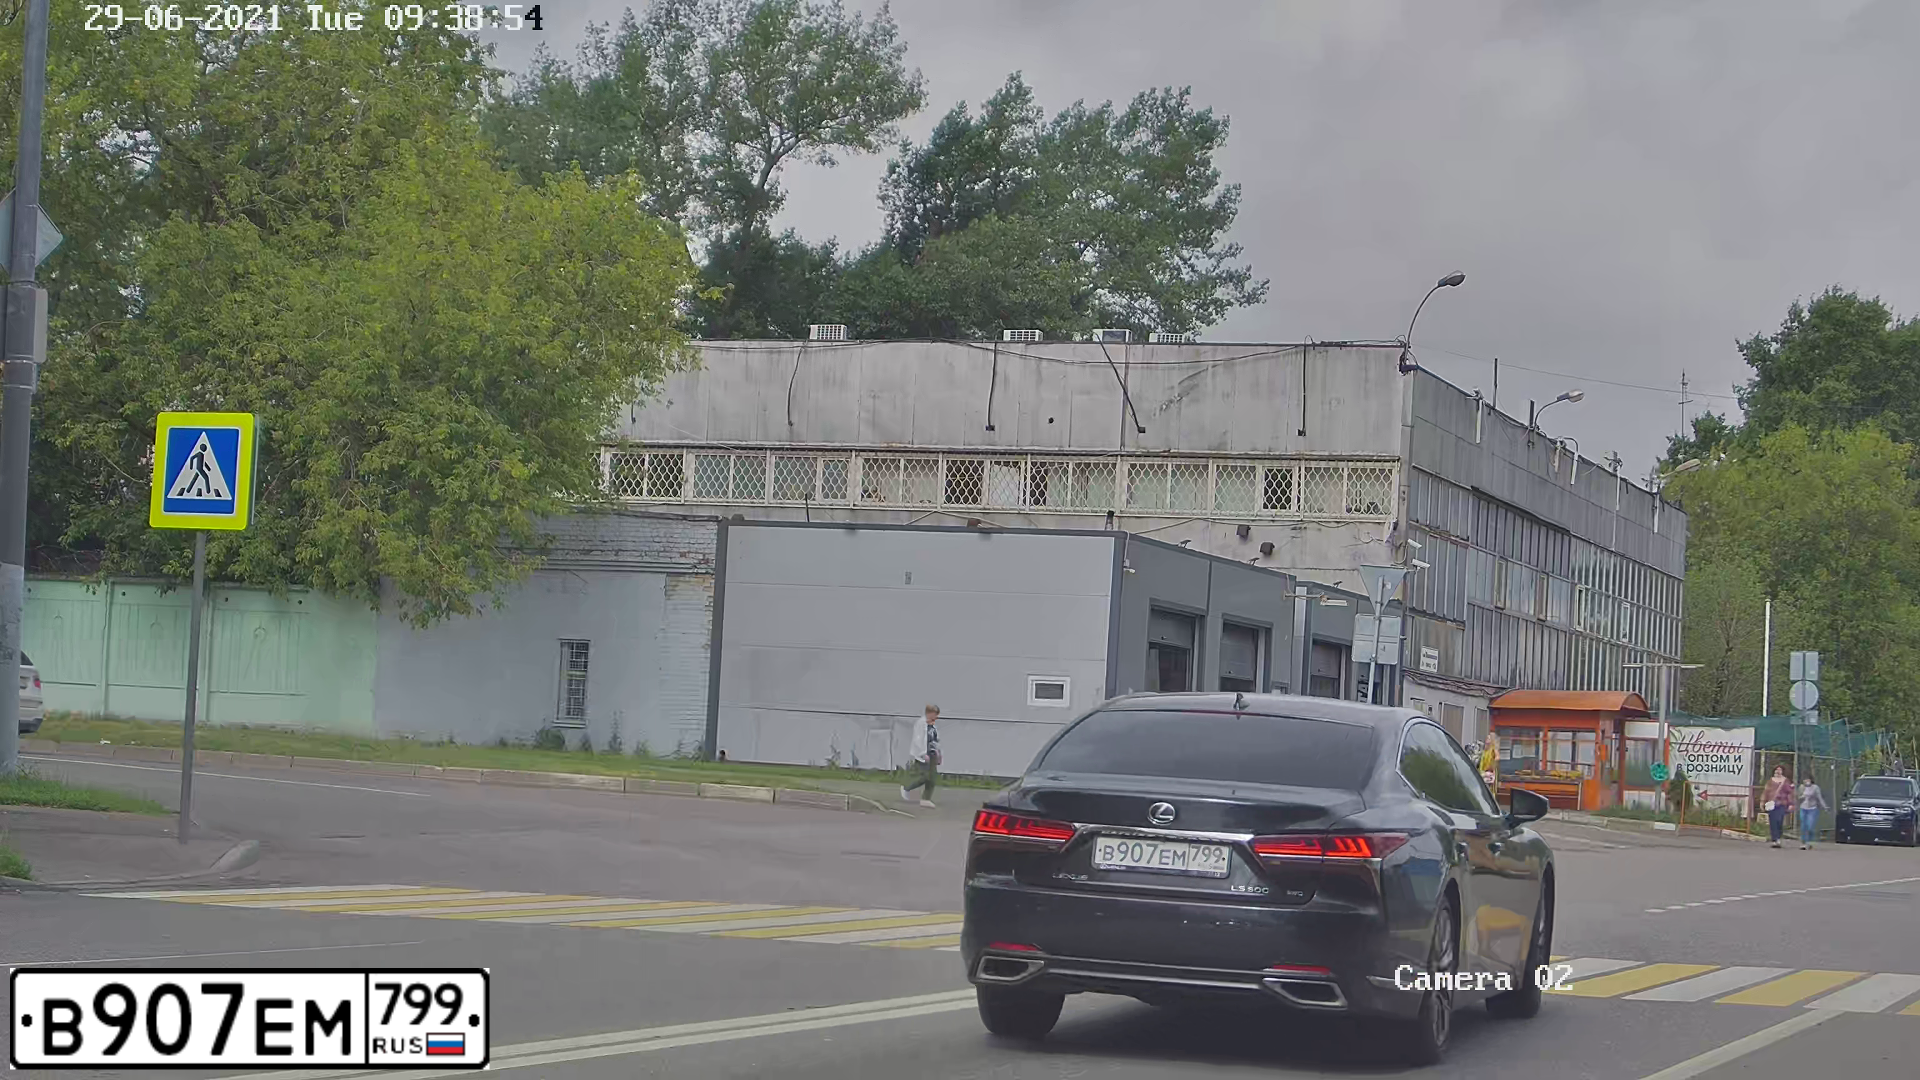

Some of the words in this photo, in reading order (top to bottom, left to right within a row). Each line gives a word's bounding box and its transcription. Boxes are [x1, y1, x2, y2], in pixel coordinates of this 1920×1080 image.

[1677, 730, 1744, 756] Цветы
[1102, 841, 1186, 867] В907ЕМ
[1191, 844, 1223, 863] 799
